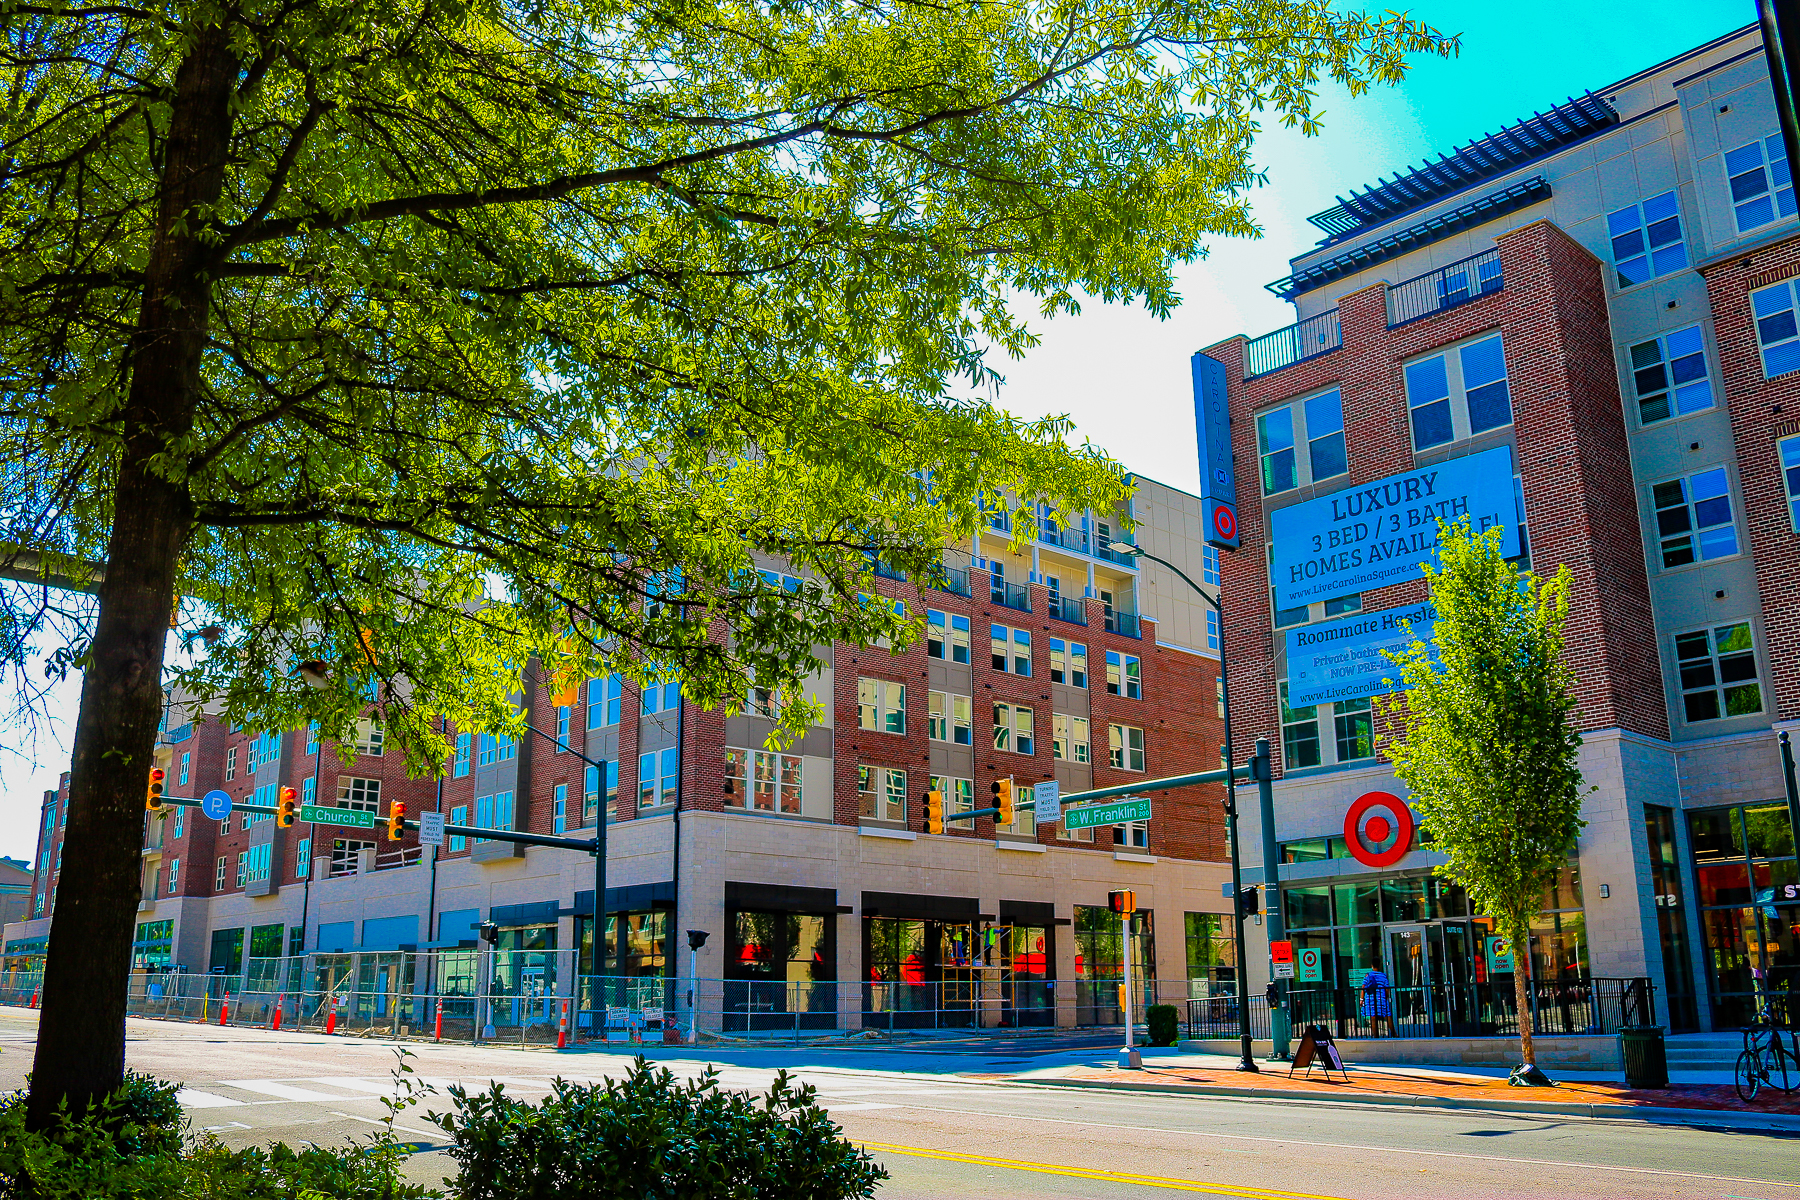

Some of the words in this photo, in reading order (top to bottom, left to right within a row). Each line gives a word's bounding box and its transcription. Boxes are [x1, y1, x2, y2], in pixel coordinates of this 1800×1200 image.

[1209, 363, 1225, 464] CAROLINA
[1332, 471, 1438, 522] LUXURY
[1312, 534, 1322, 553] 3
[1328, 523, 1369, 549] BED
[1390, 515, 1401, 533] 3
[1407, 495, 1470, 528] BATH
[1290, 549, 1362, 584] HOMES
[1297, 619, 1379, 647] Roommate
[1313, 652, 1349, 668] Private
[1330, 664, 1356, 679] NOW
[315, 809, 356, 824] Church
[1138, 803, 1147, 811] St
[1400, 931, 1411, 939] 143
